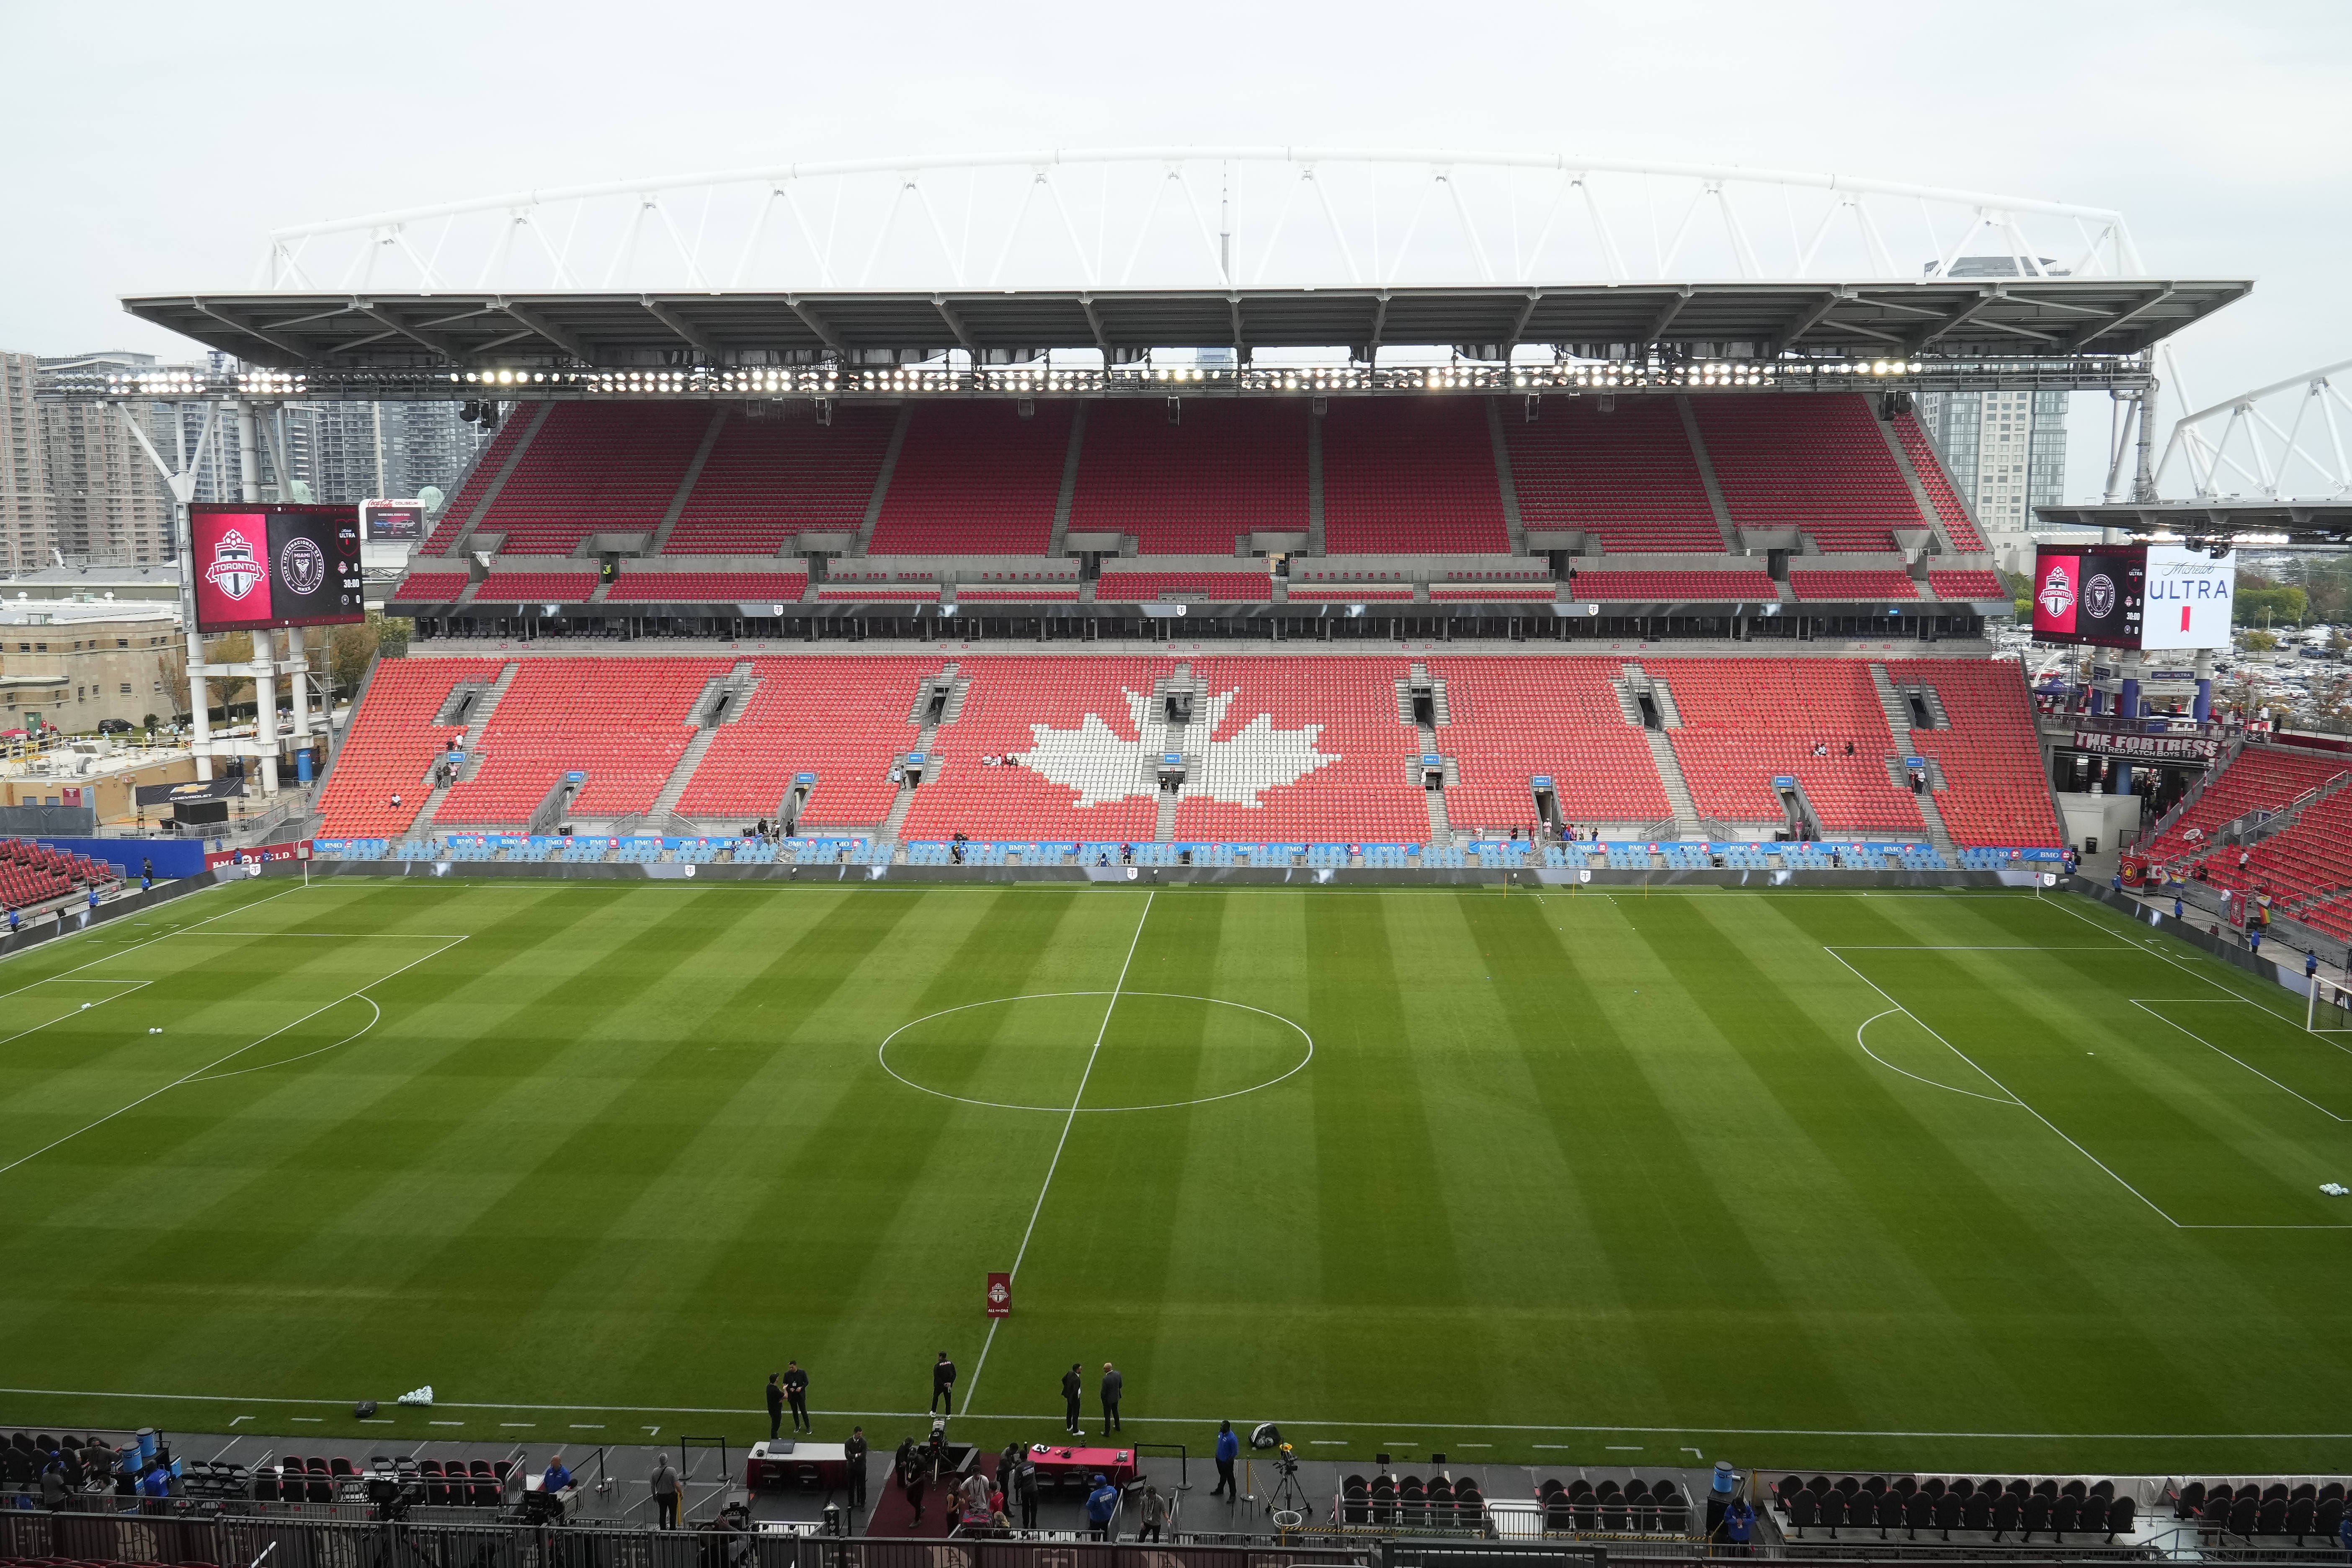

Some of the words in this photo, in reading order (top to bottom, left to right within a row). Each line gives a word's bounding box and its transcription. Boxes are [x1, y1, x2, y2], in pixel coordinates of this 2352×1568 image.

[283, 540, 314, 563] INTERNACIONAL
[214, 562, 256, 572] TORONTO
[2162, 562, 2217, 576] Michelob
[343, 579, 360, 588] 30:00
[2149, 580, 2228, 600] ULTRA
[2126, 612, 2140, 620] 30:00
[2076, 731, 2112, 749] THE
[2116, 736, 2218, 757] FORTRESS
